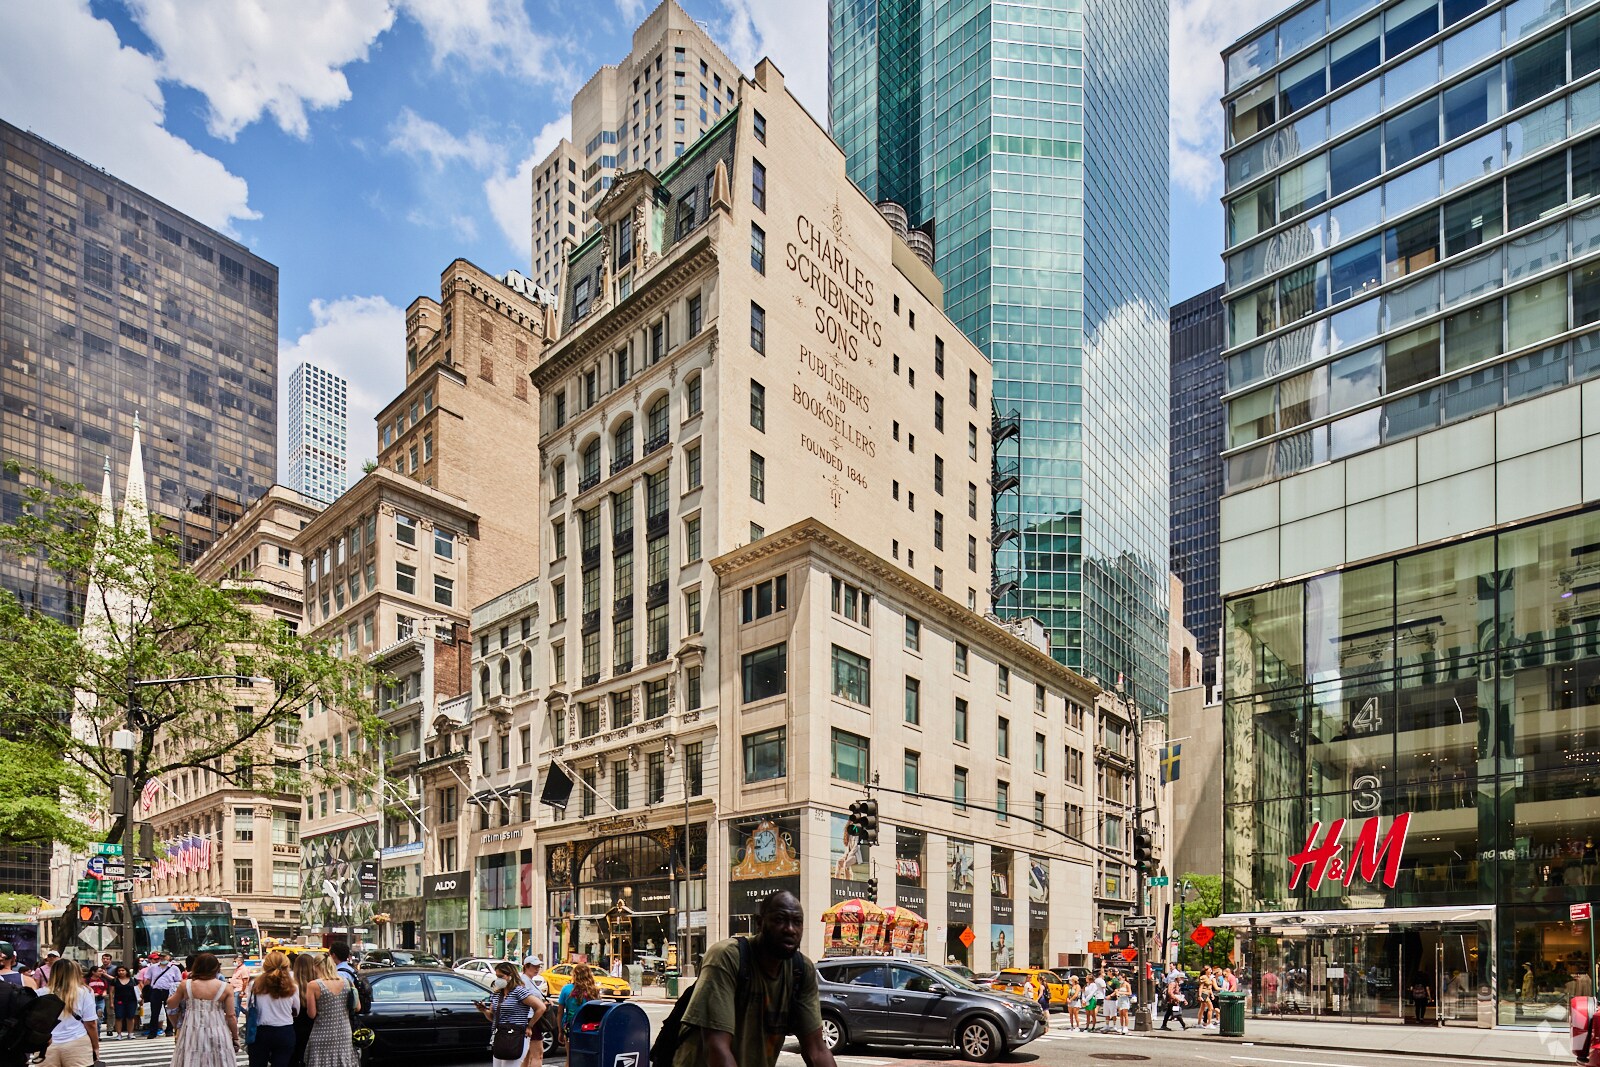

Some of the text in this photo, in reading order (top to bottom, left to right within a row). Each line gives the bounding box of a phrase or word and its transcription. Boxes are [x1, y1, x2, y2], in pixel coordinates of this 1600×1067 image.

[797, 214, 874, 306] CHARLES
[786, 242, 882, 347] SCRIBNER'S
[815, 306, 858, 361] SONS
[800, 344, 870, 413] PUBLISHERS
[792, 383, 876, 458] BOOKSELLERS
[826, 390, 846, 414] AND
[801, 433, 868, 489] FOUNDED 1846
[1352, 697, 1383, 732] 4
[1352, 775, 1382, 812] 3
[98, 845, 105, 853] W
[106, 845, 116, 854] 48
[480, 830, 523, 844] intimissimi
[1287, 812, 1412, 892] H&M
[434, 880, 457, 891] ALDO
[848, 890, 865, 898] BAKER
